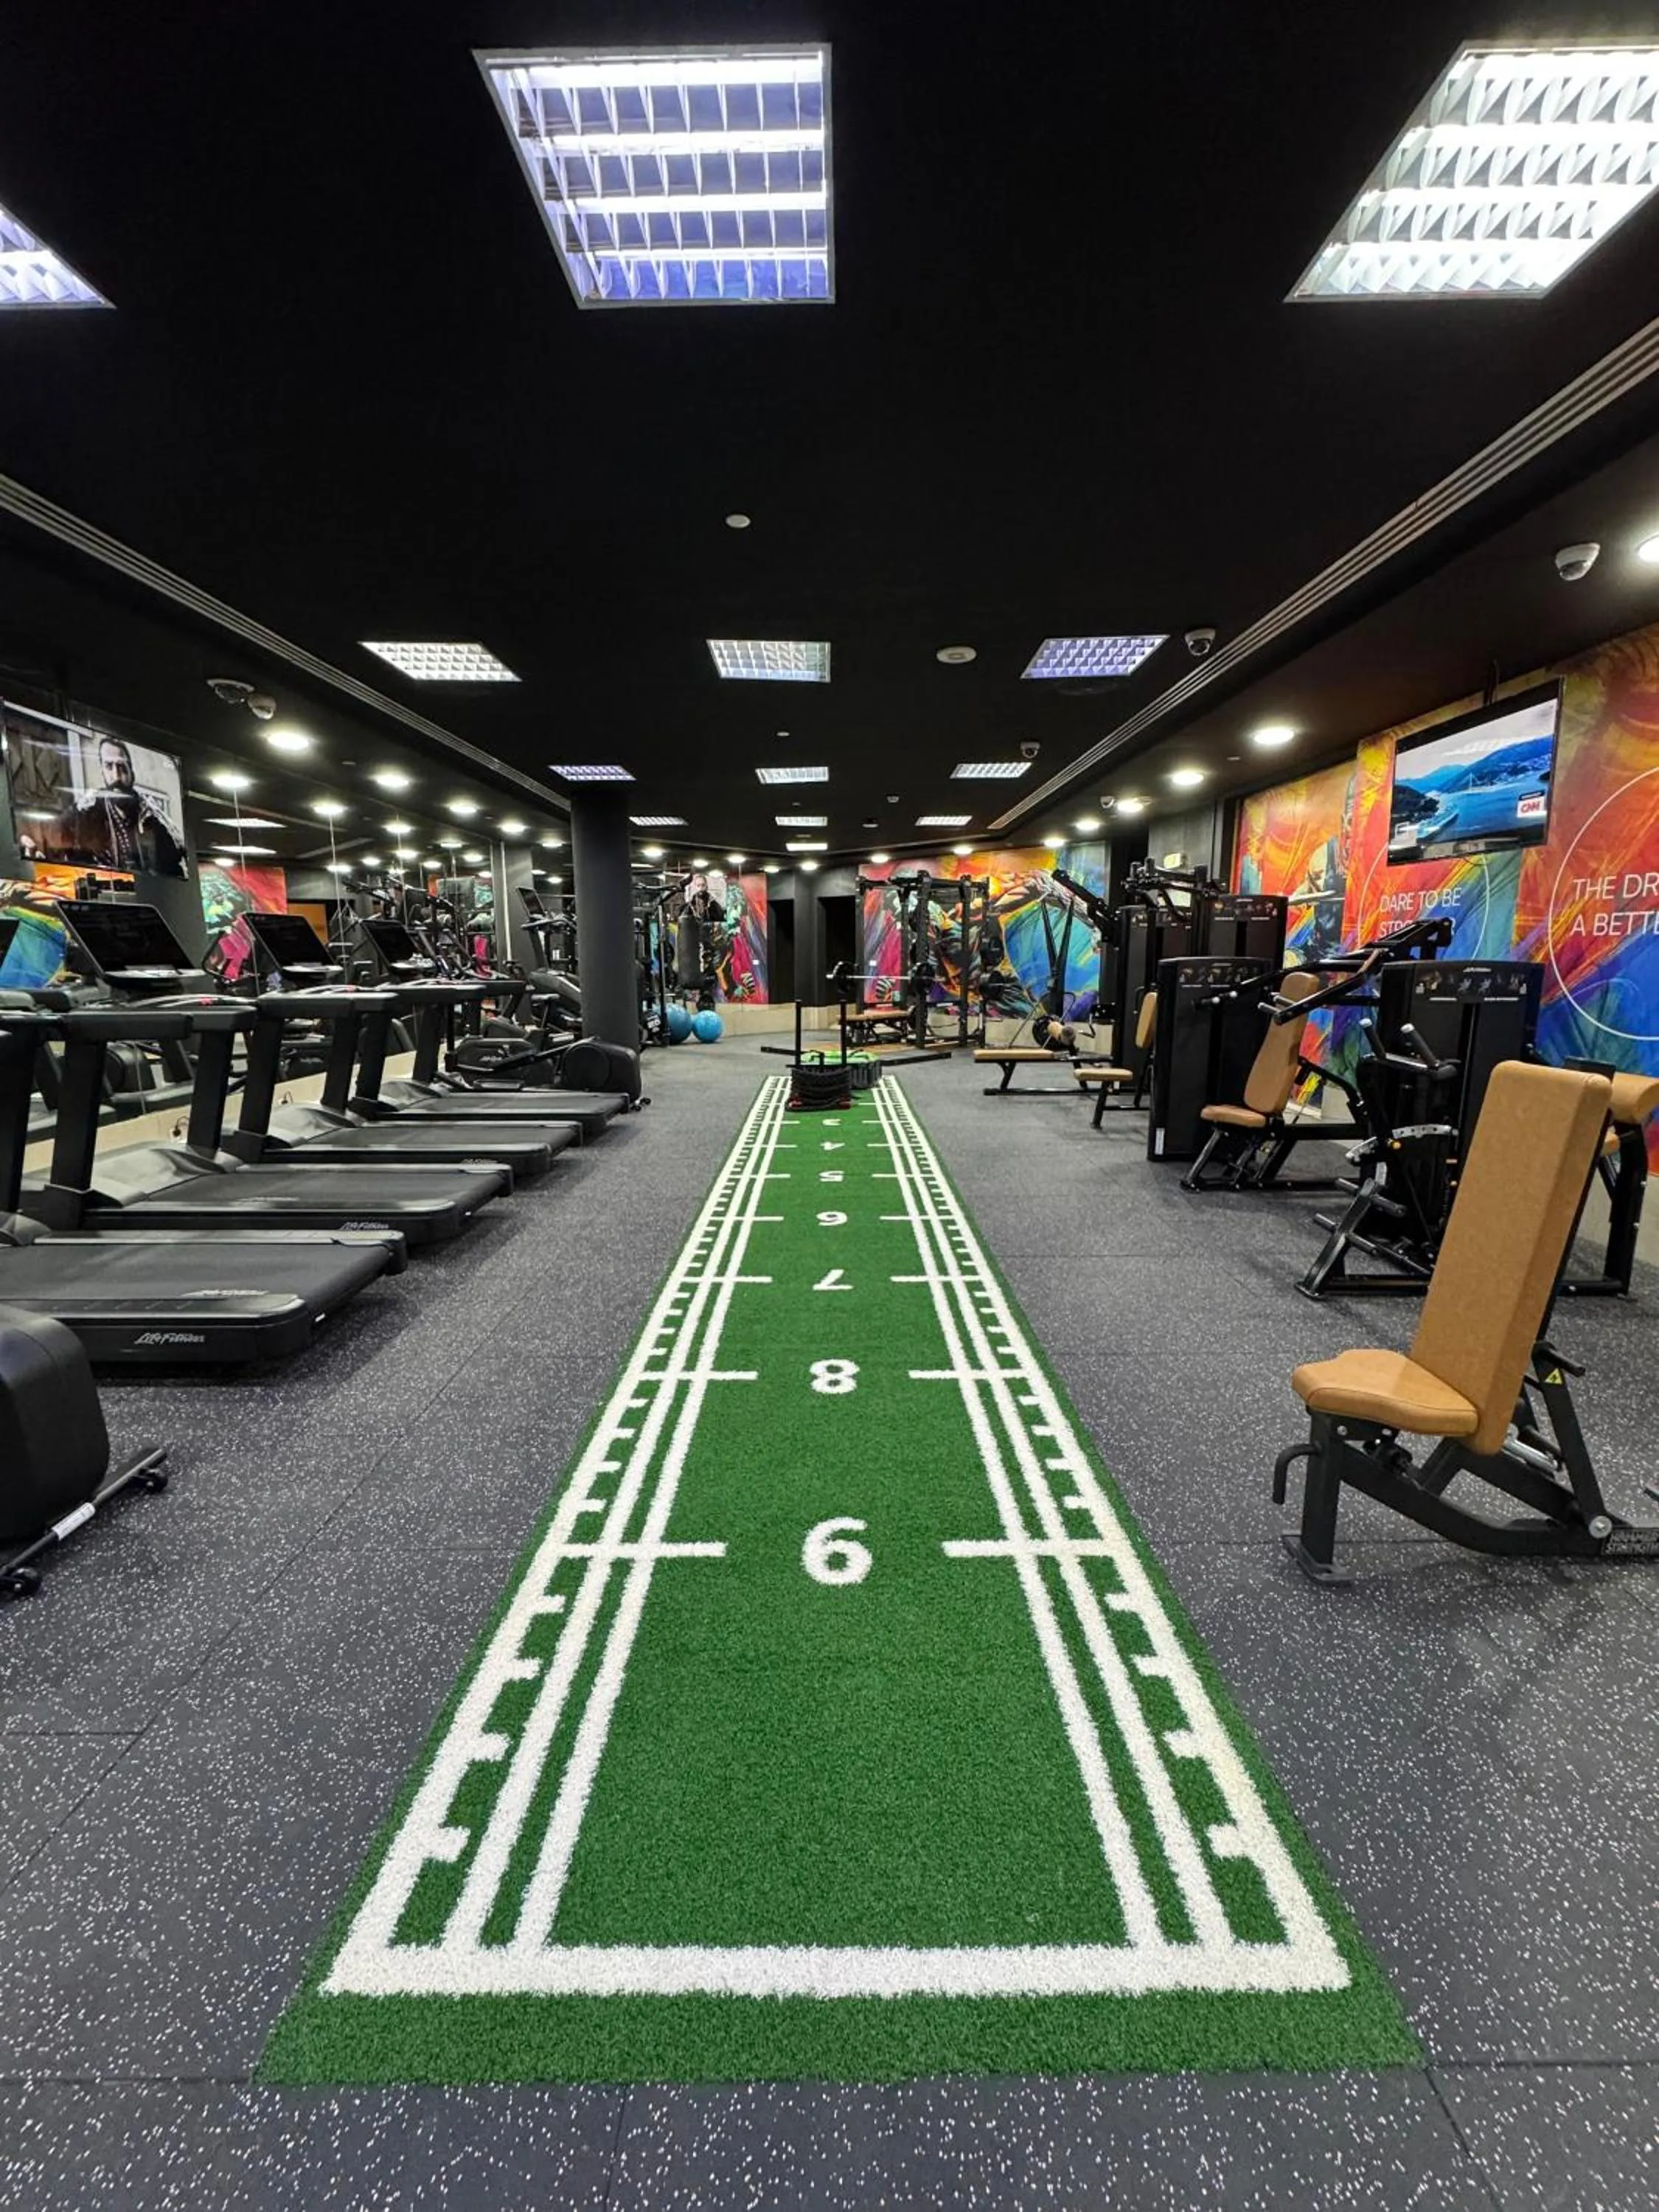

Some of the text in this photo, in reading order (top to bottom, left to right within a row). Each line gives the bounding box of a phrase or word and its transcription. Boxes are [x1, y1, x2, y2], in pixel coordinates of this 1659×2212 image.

[1573, 875, 1617, 900] THE
[1380, 887, 1462, 913] DARE TO BE
[1569, 914, 1586, 936] A
[818, 1170, 845, 1182] 5
[813, 1269, 854, 1290] 7
[810, 1359, 860, 1394] 8
